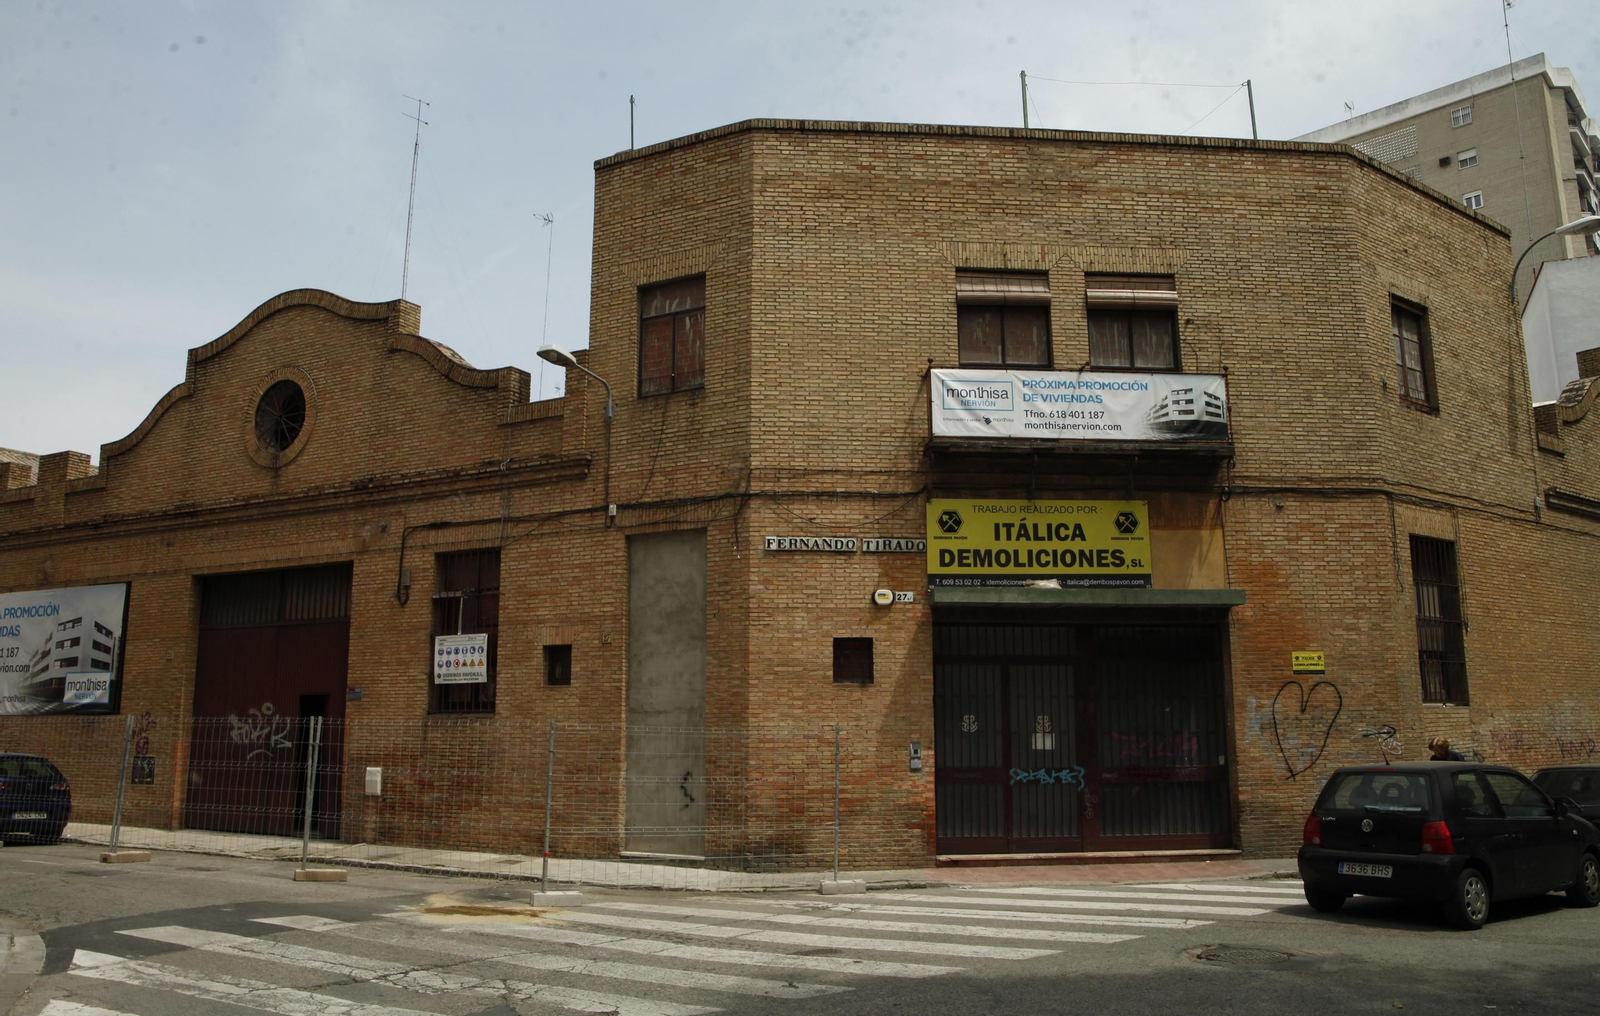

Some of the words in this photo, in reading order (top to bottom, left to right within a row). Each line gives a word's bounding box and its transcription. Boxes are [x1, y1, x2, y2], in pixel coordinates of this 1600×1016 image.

[1022, 378, 1076, 389] PRÓXIMA
[1078, 380, 1148, 391] PROMOCIÓN
[946, 387, 1009, 399] monthisa
[1023, 393, 1038, 402] DE
[1040, 393, 1103, 404] VIVIENDAS
[961, 399, 996, 407] NERVIÓN
[1024, 409, 1047, 419] Tfno.
[1049, 410, 1067, 419] 618
[1068, 411, 1085, 419] 401
[1088, 411, 1104, 420] 187
[1024, 421, 1122, 431] monthisanervion.com
[972, 505, 1017, 514] TRABAJO
[1019, 505, 1074, 514] REALIZADO
[1076, 506, 1098, 514] POR
[994, 517, 1087, 542] ITÁLICA
[766, 537, 856, 549] FERNANDO
[863, 539, 926, 551] TIRADO
[3, 601, 60, 619] PROMOCIÓN
[6, 646, 20, 658] 187
[66, 678, 108, 692] monthisa
[1345, 863, 1369, 875] 3636
[1371, 865, 1390, 876] BHS
